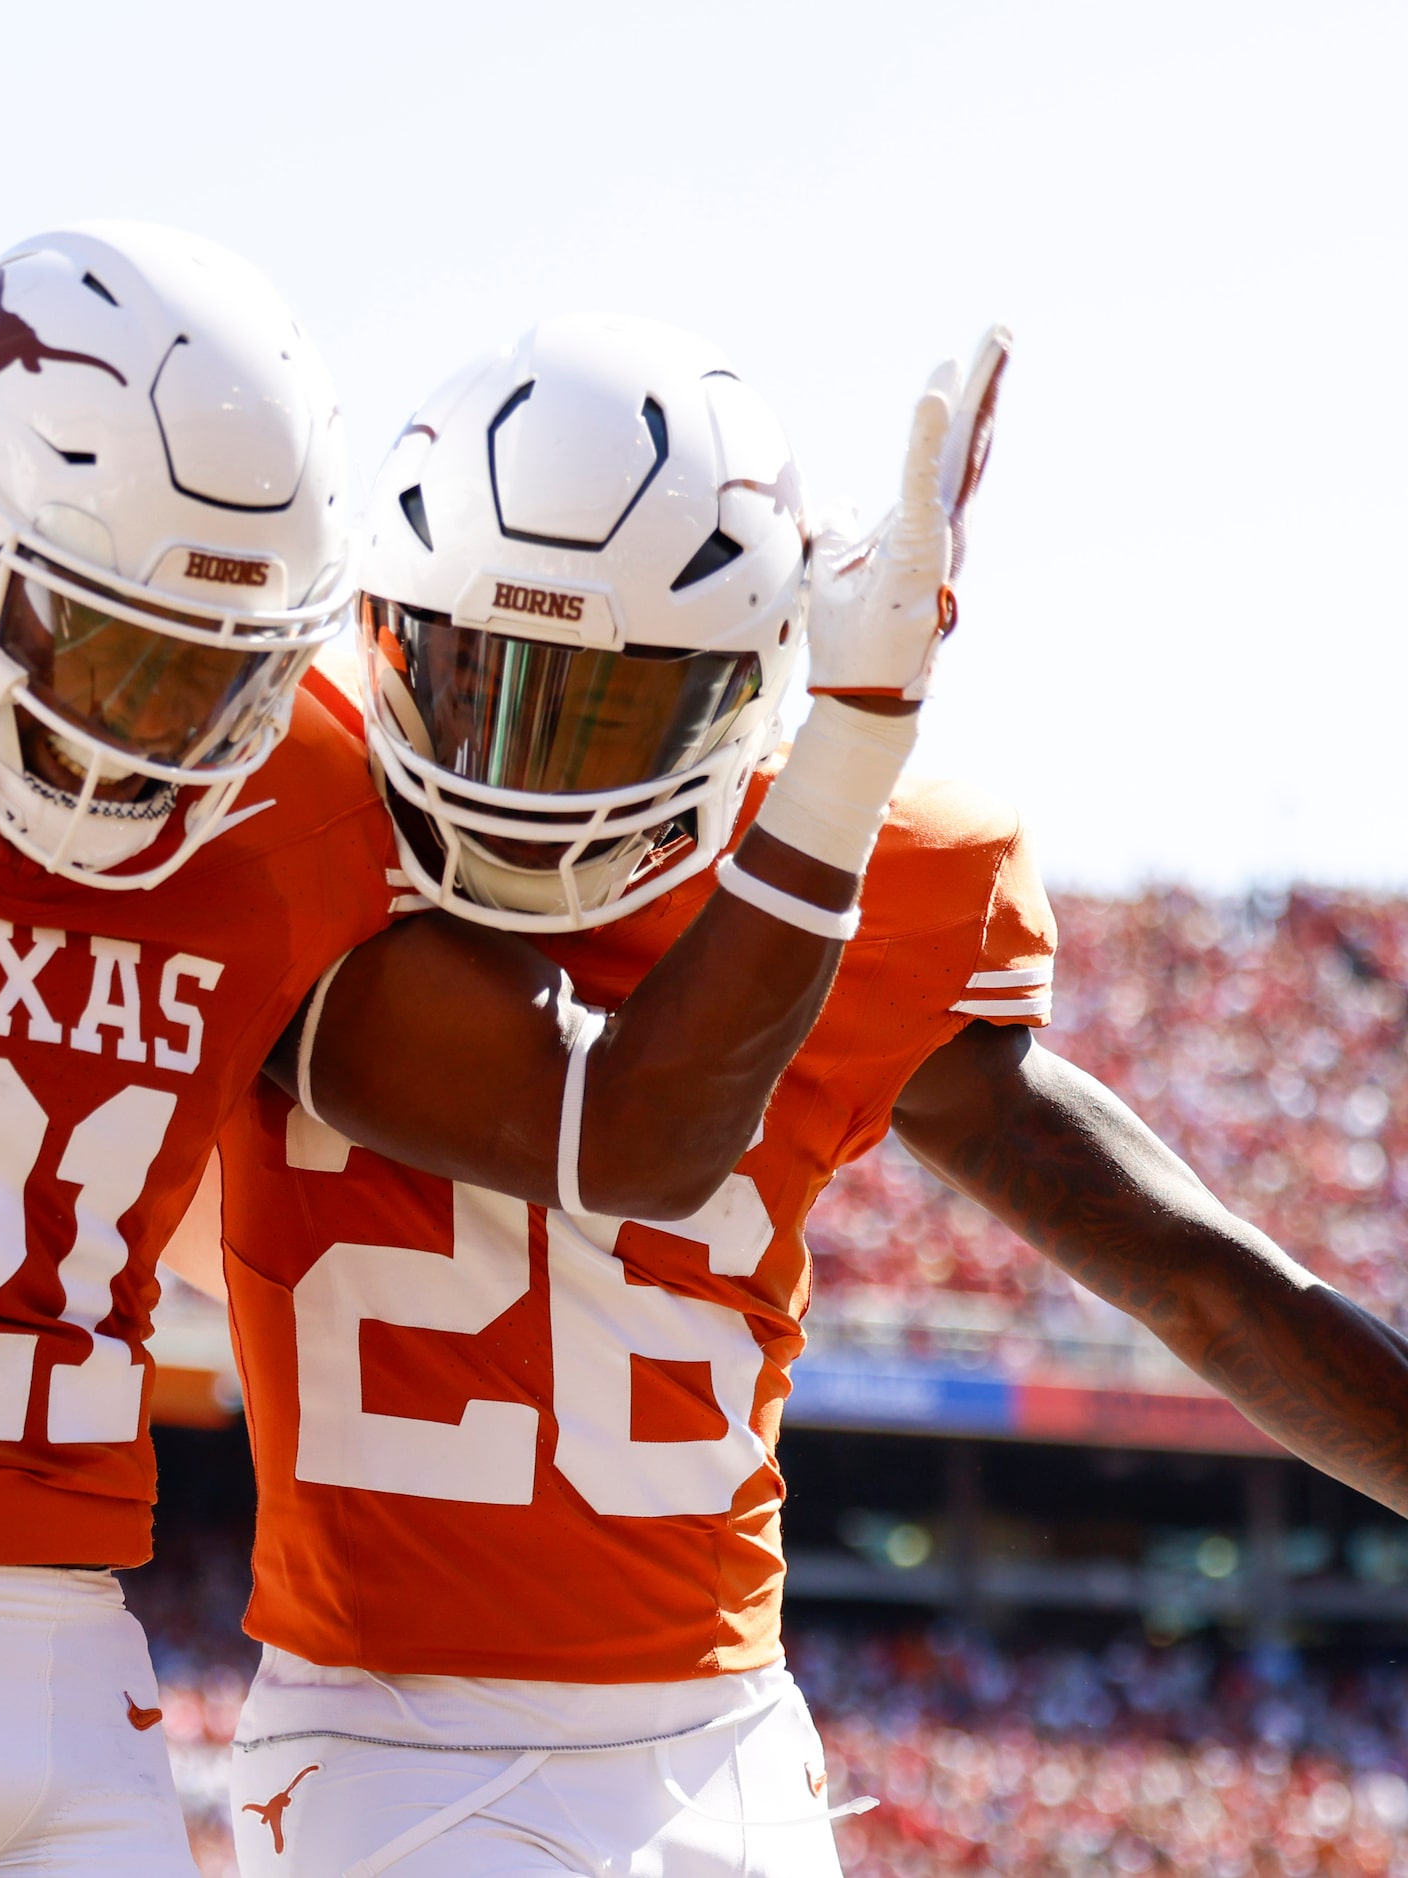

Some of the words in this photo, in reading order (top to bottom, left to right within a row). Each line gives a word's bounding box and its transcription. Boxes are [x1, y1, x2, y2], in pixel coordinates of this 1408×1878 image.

[183, 552, 271, 587] HORNS
[492, 582, 584, 621] HORNS
[285, 1102, 776, 1517] 26
